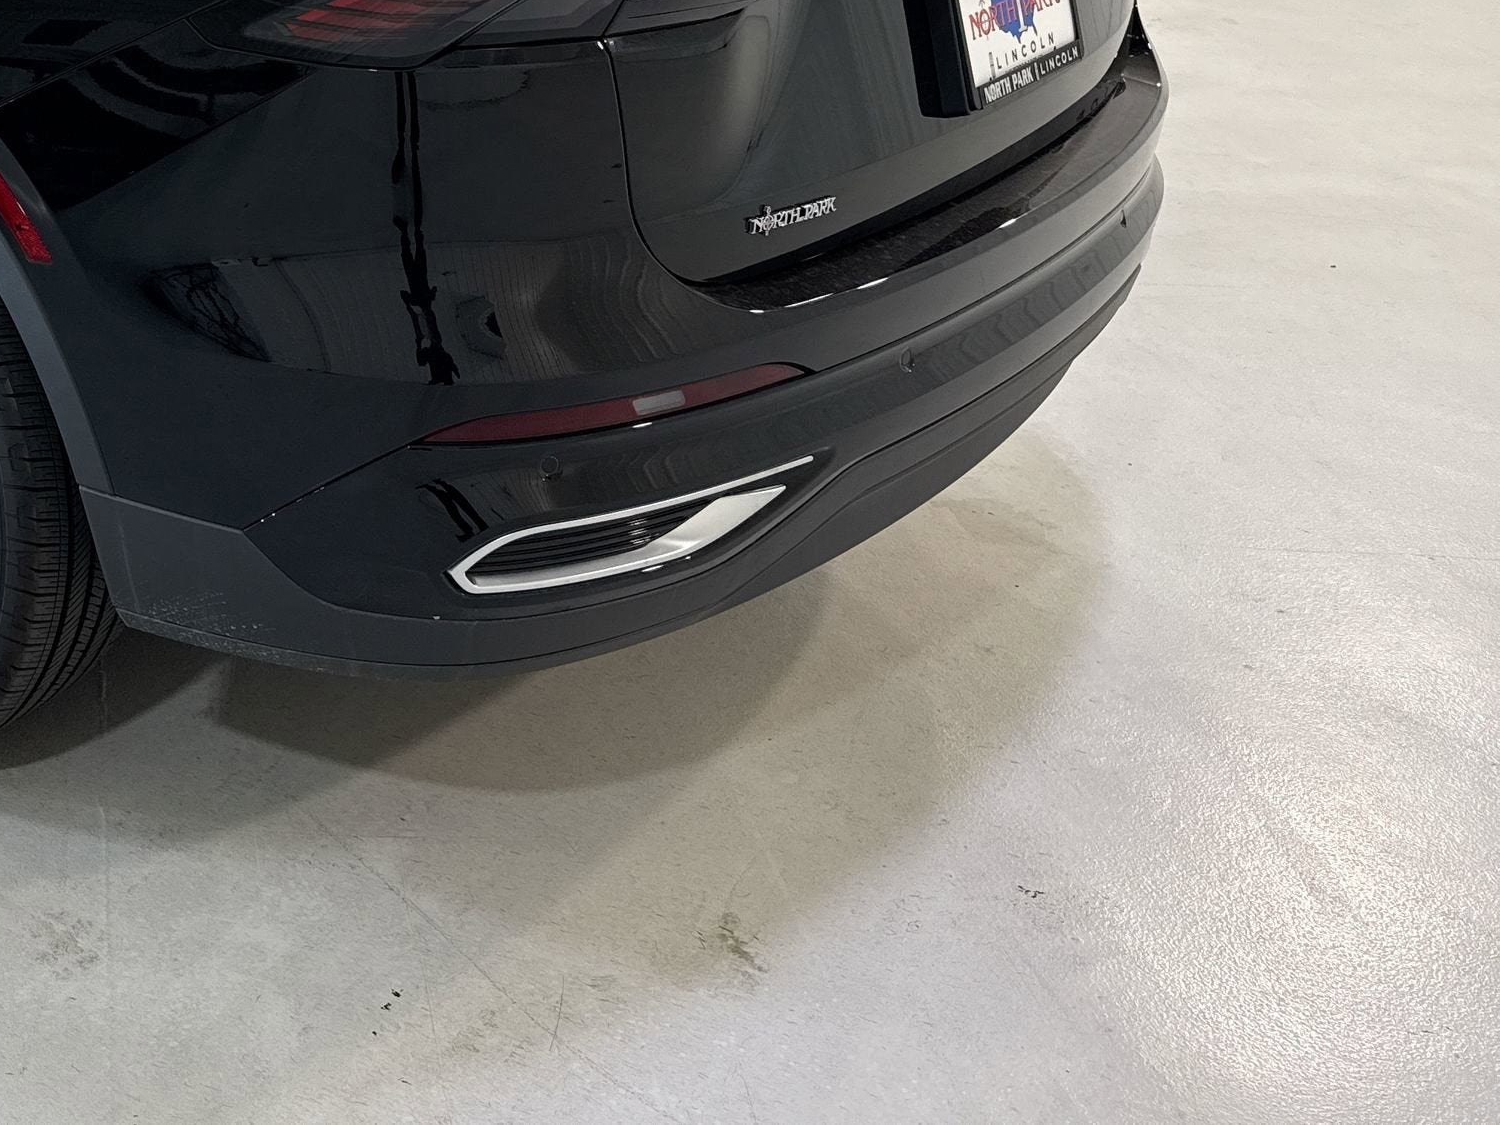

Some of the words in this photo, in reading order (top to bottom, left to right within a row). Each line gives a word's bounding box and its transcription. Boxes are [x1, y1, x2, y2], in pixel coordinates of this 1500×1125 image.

[984, 76, 1012, 103] NORTH
[1012, 65, 1034, 90] PARK
[1040, 45, 1079, 75] LINCOLN
[996, 31, 1055, 69] LINCOLN
